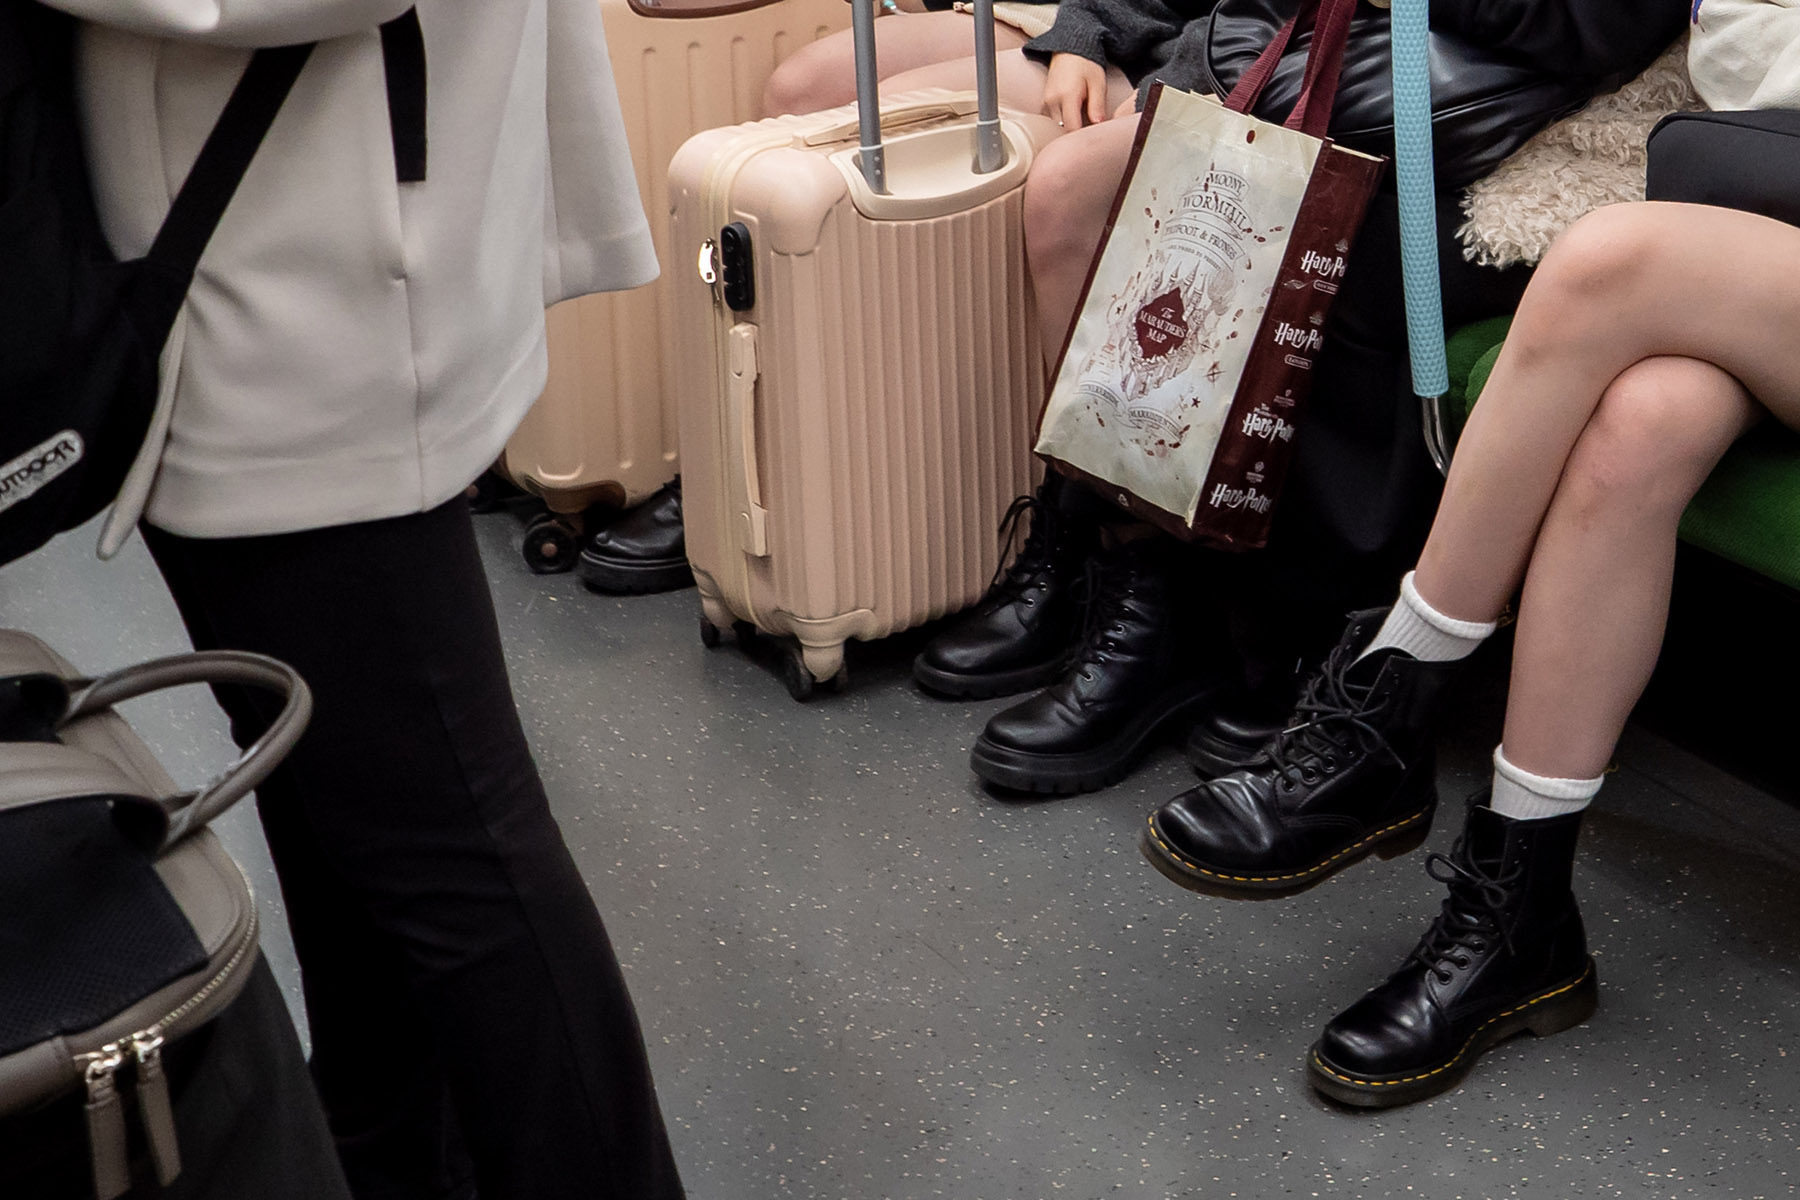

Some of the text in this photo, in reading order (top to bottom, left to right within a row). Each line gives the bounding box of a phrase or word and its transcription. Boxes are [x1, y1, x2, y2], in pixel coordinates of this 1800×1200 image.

[1300, 249, 1348, 280] Harry Po
[1273, 321, 1308, 349] Harry
[1241, 412, 1275, 439] Harry
[0, 440, 76, 497] UTDOOR
[1208, 482, 1247, 509] Harry
